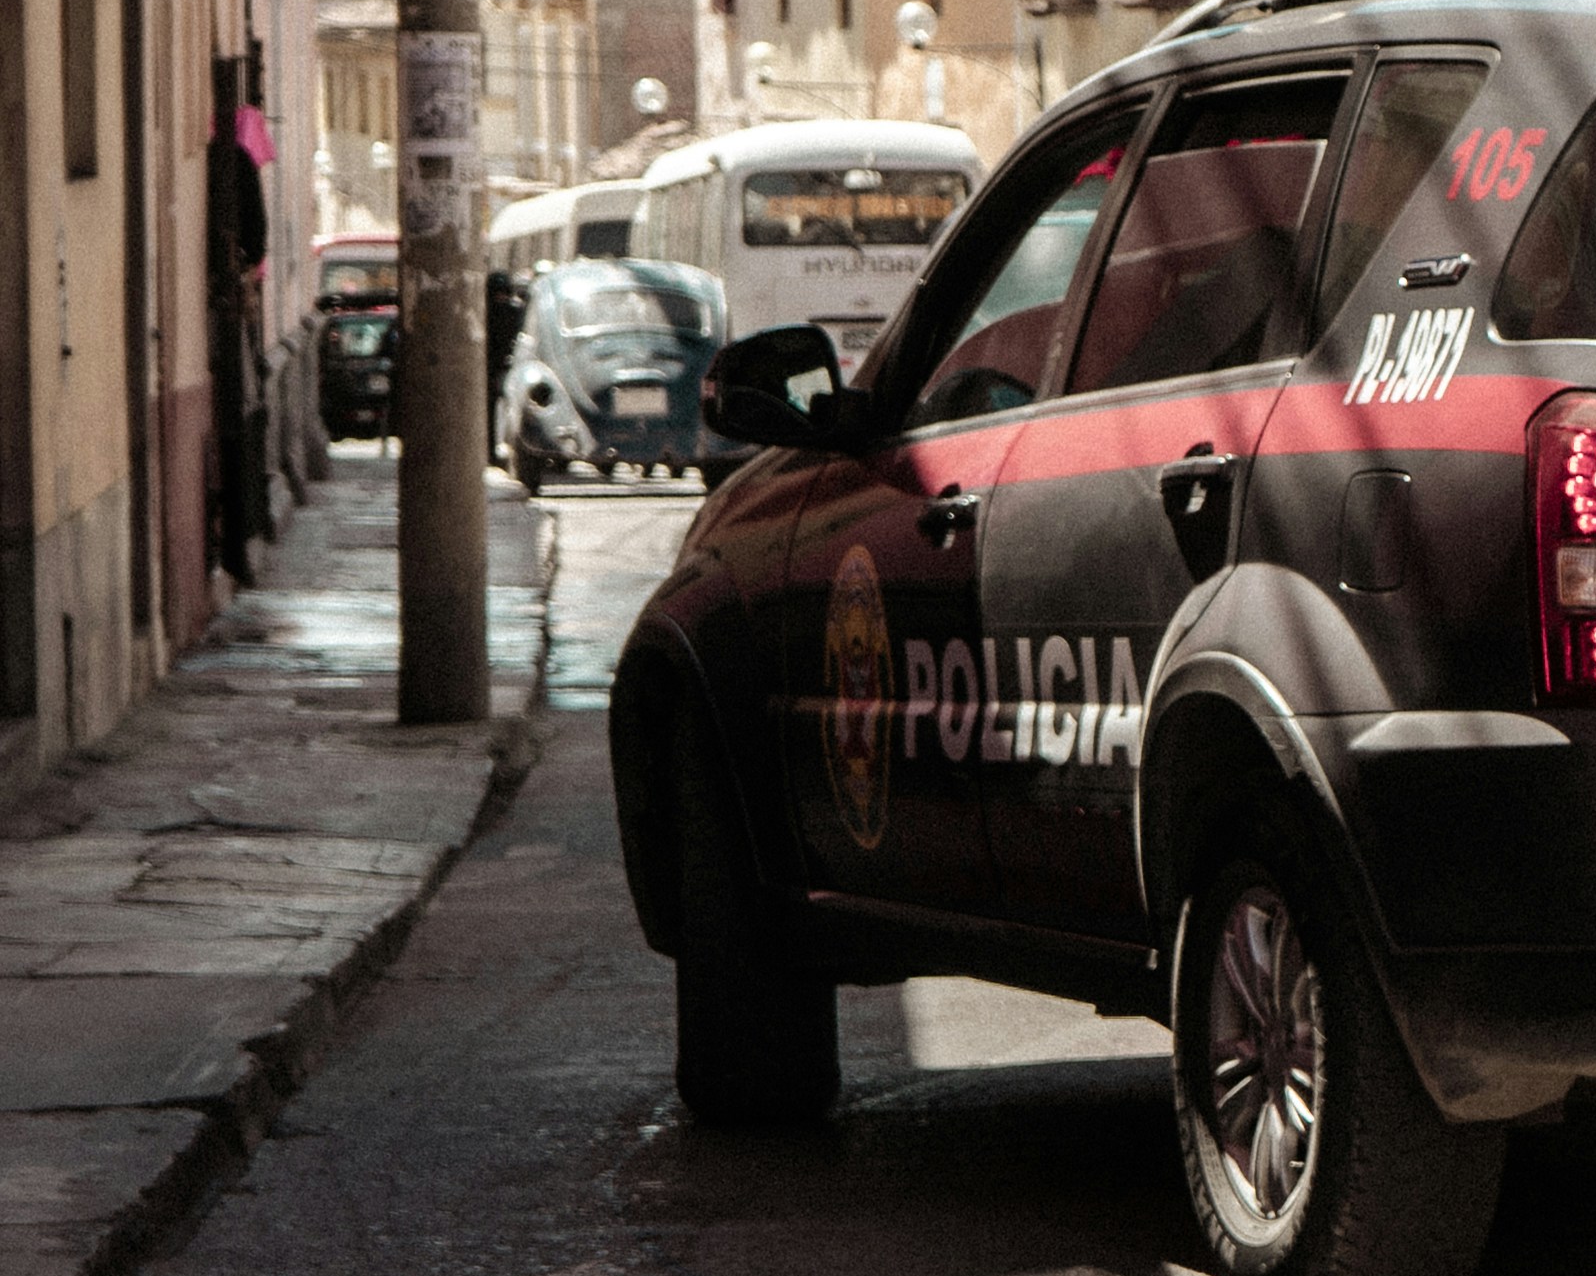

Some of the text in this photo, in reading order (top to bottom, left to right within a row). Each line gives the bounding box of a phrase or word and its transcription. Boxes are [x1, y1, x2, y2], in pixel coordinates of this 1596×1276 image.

[1446, 126, 1548, 202] 105
[1343, 306, 1475, 405] PL-19871
[903, 635, 1143, 769] POLICIA
